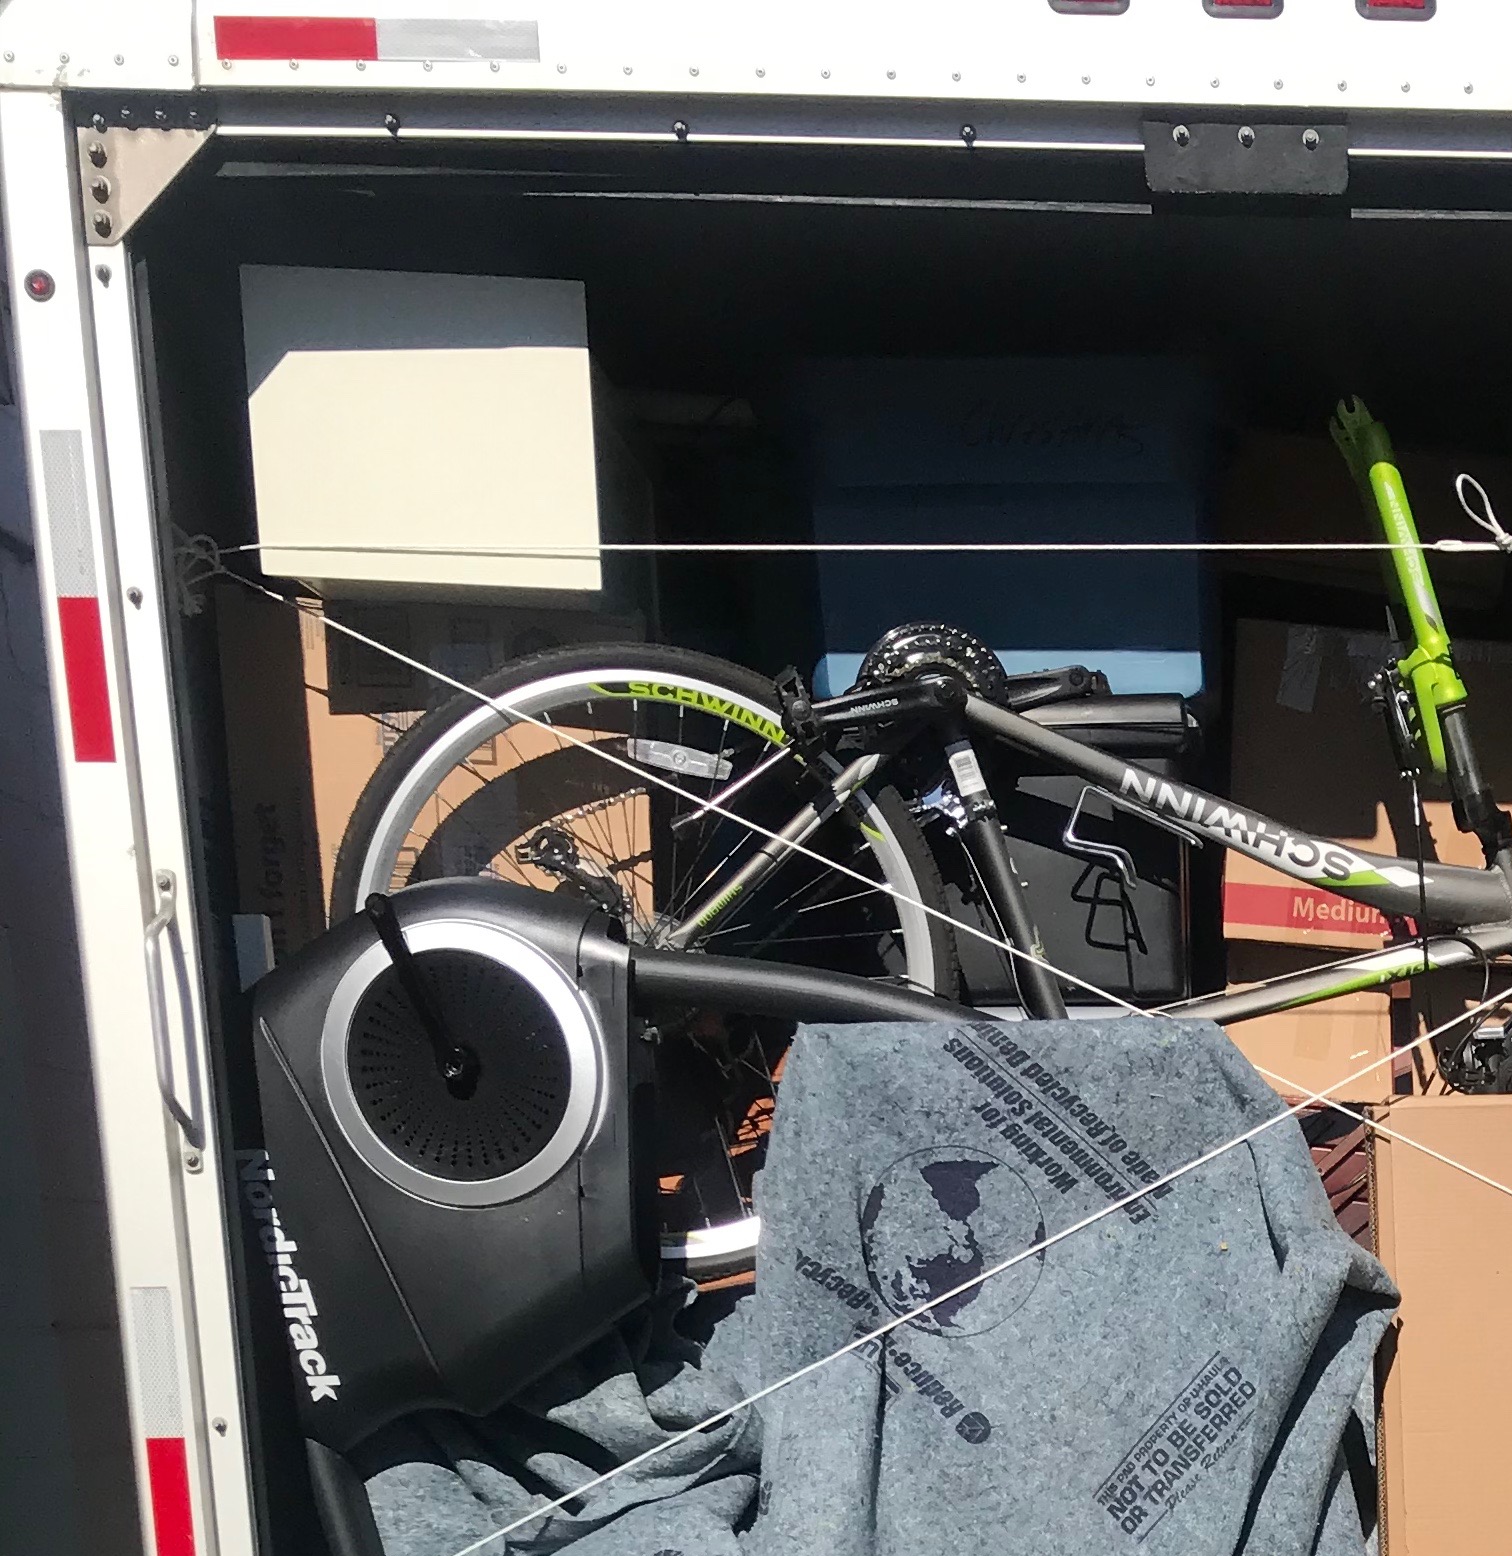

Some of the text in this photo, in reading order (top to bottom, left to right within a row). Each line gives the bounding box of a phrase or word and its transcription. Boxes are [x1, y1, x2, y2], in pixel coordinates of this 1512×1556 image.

[628, 681, 787, 742] SCHWINN
[850, 698, 899, 715] SCHWINN
[1120, 768, 1354, 880] SCHWINN
[943, 1037, 1033, 1117] Solutions
[1020, 1062, 1110, 1140] Recycled
[971, 1100, 1079, 1194] Working for
[238, 1150, 341, 1402] NordicTrack
[1106, 1366, 1243, 1522] NOT TO BE SOLD
[1120, 1381, 1256, 1535] OR TRANSFERRED
[1134, 1412, 1179, 1463] PROPERTY
